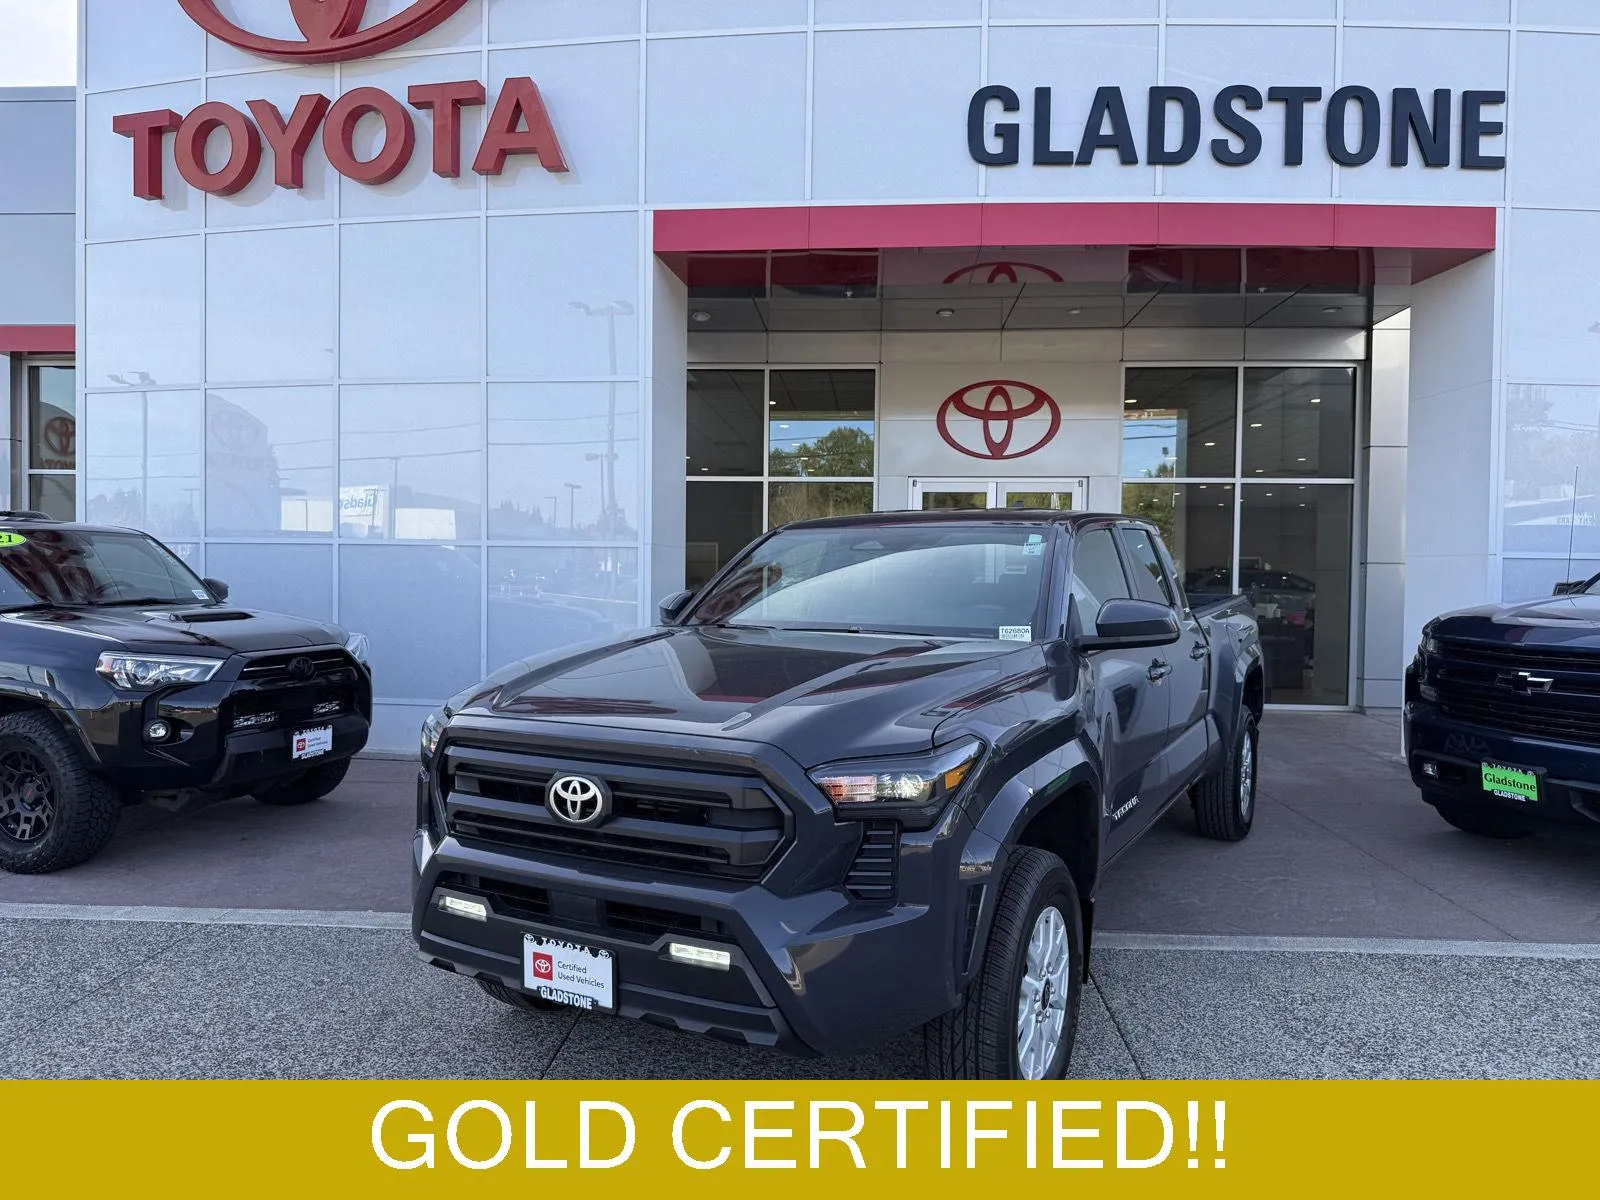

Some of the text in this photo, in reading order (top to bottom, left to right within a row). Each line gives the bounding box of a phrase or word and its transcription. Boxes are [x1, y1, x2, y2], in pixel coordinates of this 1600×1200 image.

[967, 84, 1506, 170] GLADSTONE
[112, 76, 570, 201] TOYOTA
[1484, 772, 1536, 792] Gladstone
[1493, 789, 1526, 802] GLADSTONE
[541, 937, 590, 954] TOYOTA
[557, 961, 587, 974] Certified
[557, 972, 605, 989] Used Vehicles
[540, 986, 593, 1010] GLADSTONE
